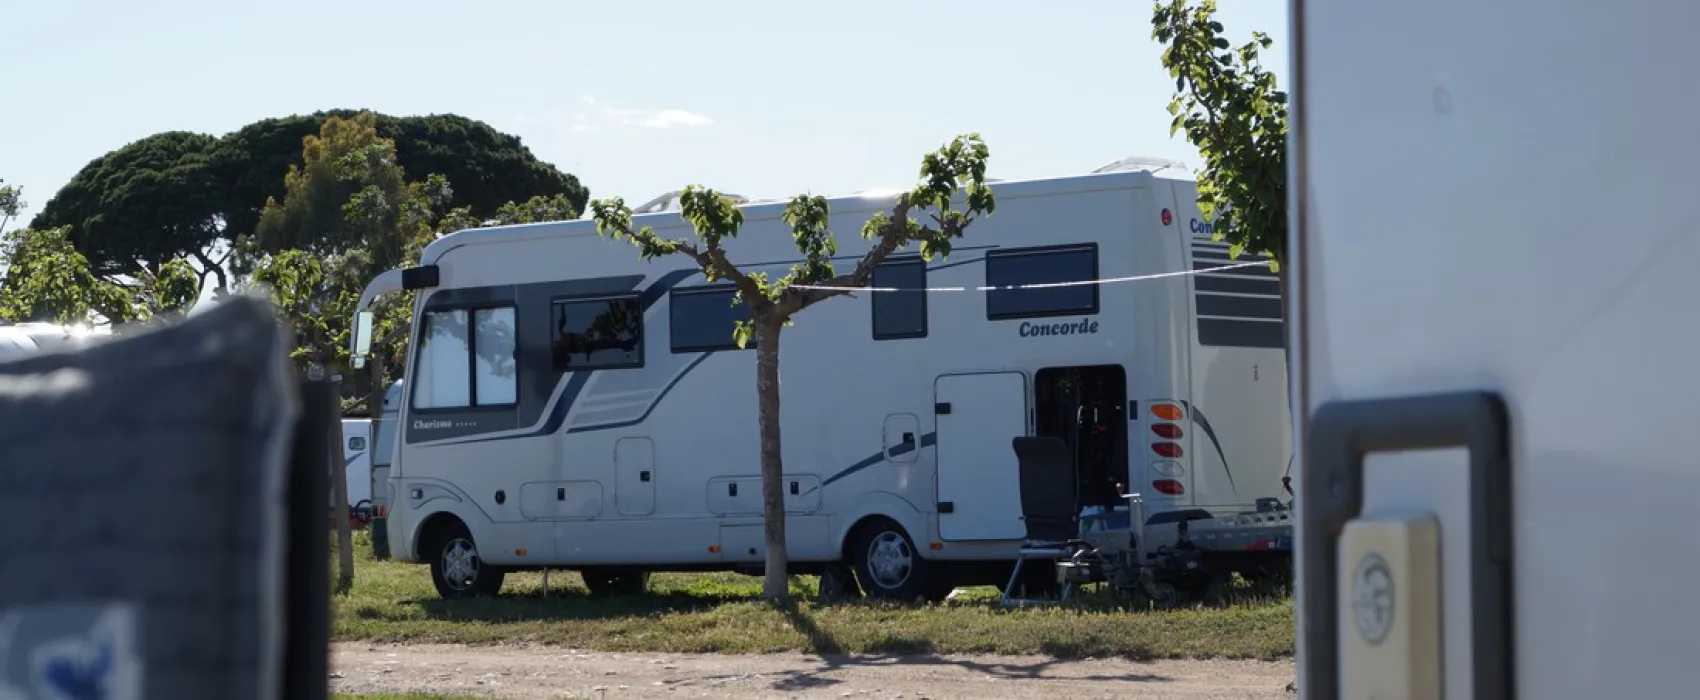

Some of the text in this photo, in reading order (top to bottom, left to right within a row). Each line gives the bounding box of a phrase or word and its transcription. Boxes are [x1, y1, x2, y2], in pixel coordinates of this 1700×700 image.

[1190, 218, 1214, 233] Con
[1019, 317, 1099, 337] Concorde
[413, 419, 452, 430] Charisma
